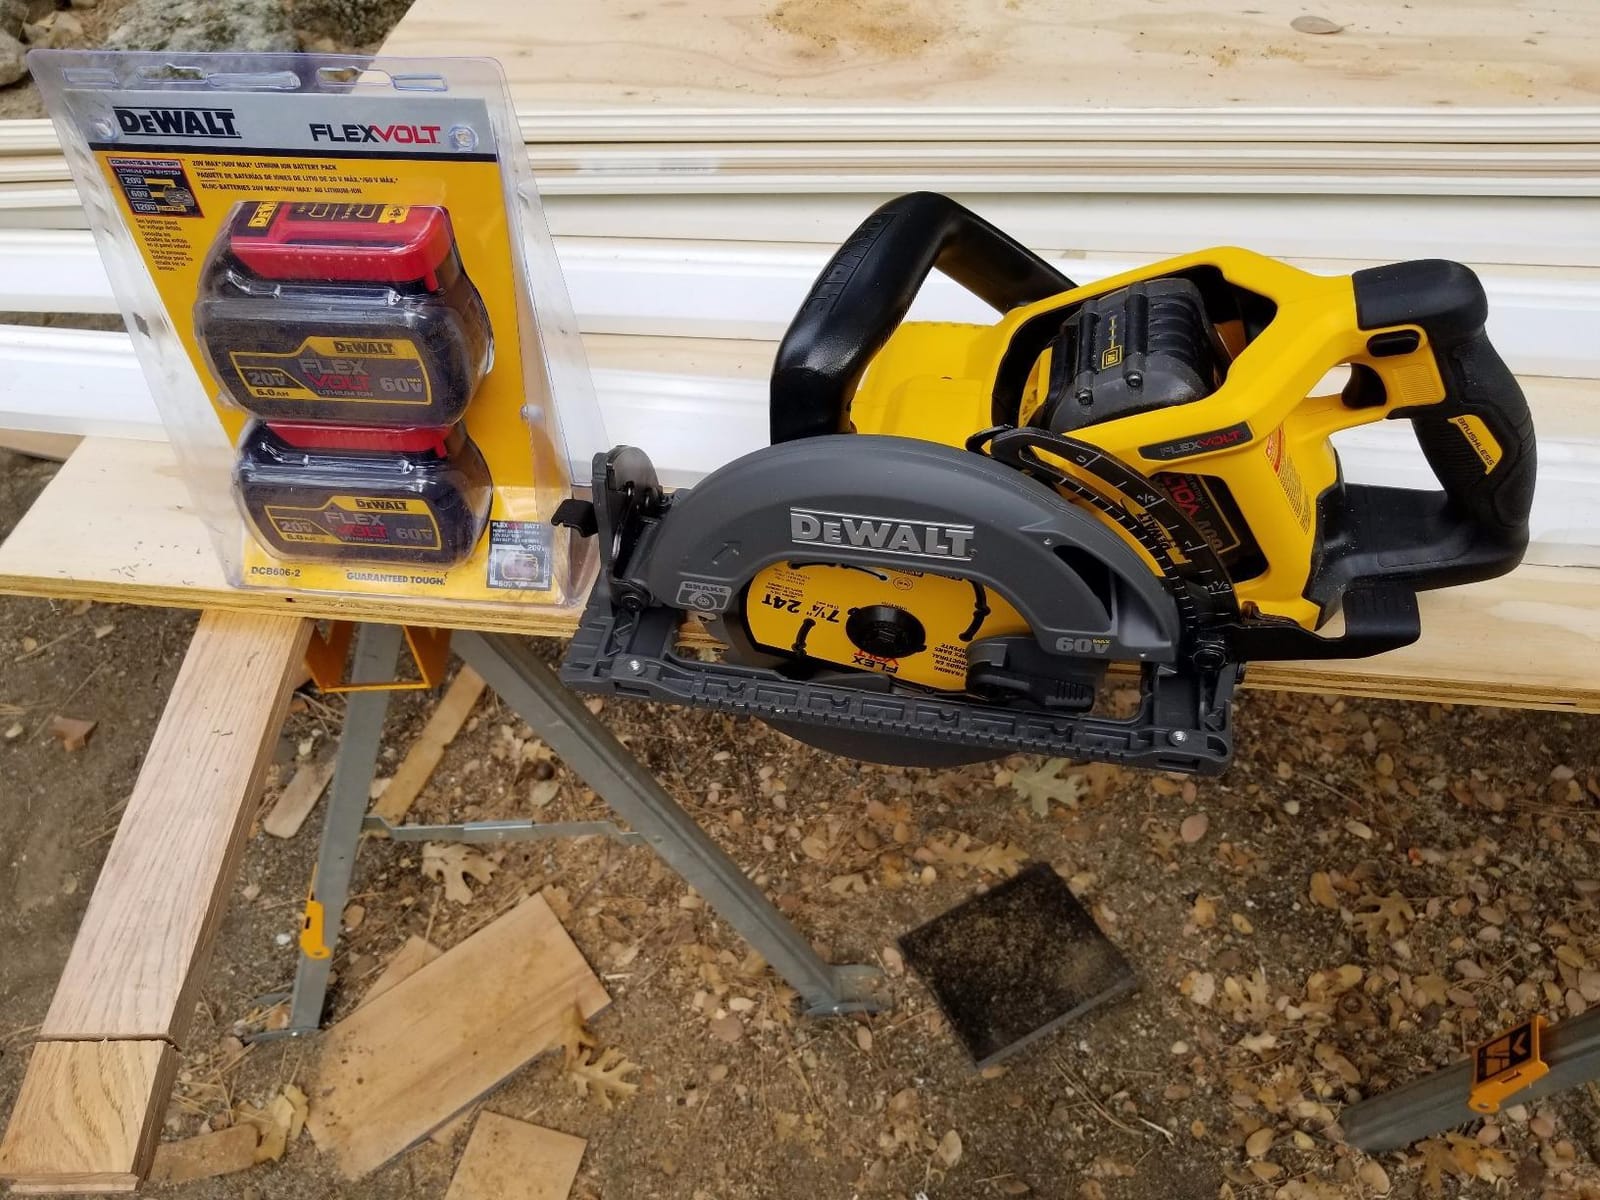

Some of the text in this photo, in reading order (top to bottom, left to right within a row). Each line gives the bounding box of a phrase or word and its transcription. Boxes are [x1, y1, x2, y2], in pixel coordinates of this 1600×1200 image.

[113, 106, 241, 138] DEWALT
[309, 123, 441, 145] FLEXVOLT
[131, 190, 148, 198] 60V
[135, 203, 156, 211] 120V
[334, 341, 395, 355] DEWALT
[298, 358, 369, 376] FLEX
[247, 371, 422, 393] 20V VOLT 60V
[1160, 430, 1241, 457] FLEXVOLT
[1457, 416, 1495, 466] BRUSHLESS
[355, 499, 408, 511] DEWALT
[324, 511, 384, 526] FLEX
[396, 527, 432, 541] 60V
[791, 509, 975, 560] DEWALT
[251, 566, 301, 577] DCB606-2
[346, 571, 408, 583] GUARANTEED
[685, 583, 729, 593] BRAKE
[761, 593, 803, 614] 24T
[1055, 637, 1110, 654] 60V
[852, 655, 899, 675] FLEX
[933, 666, 964, 677] FRAMING
